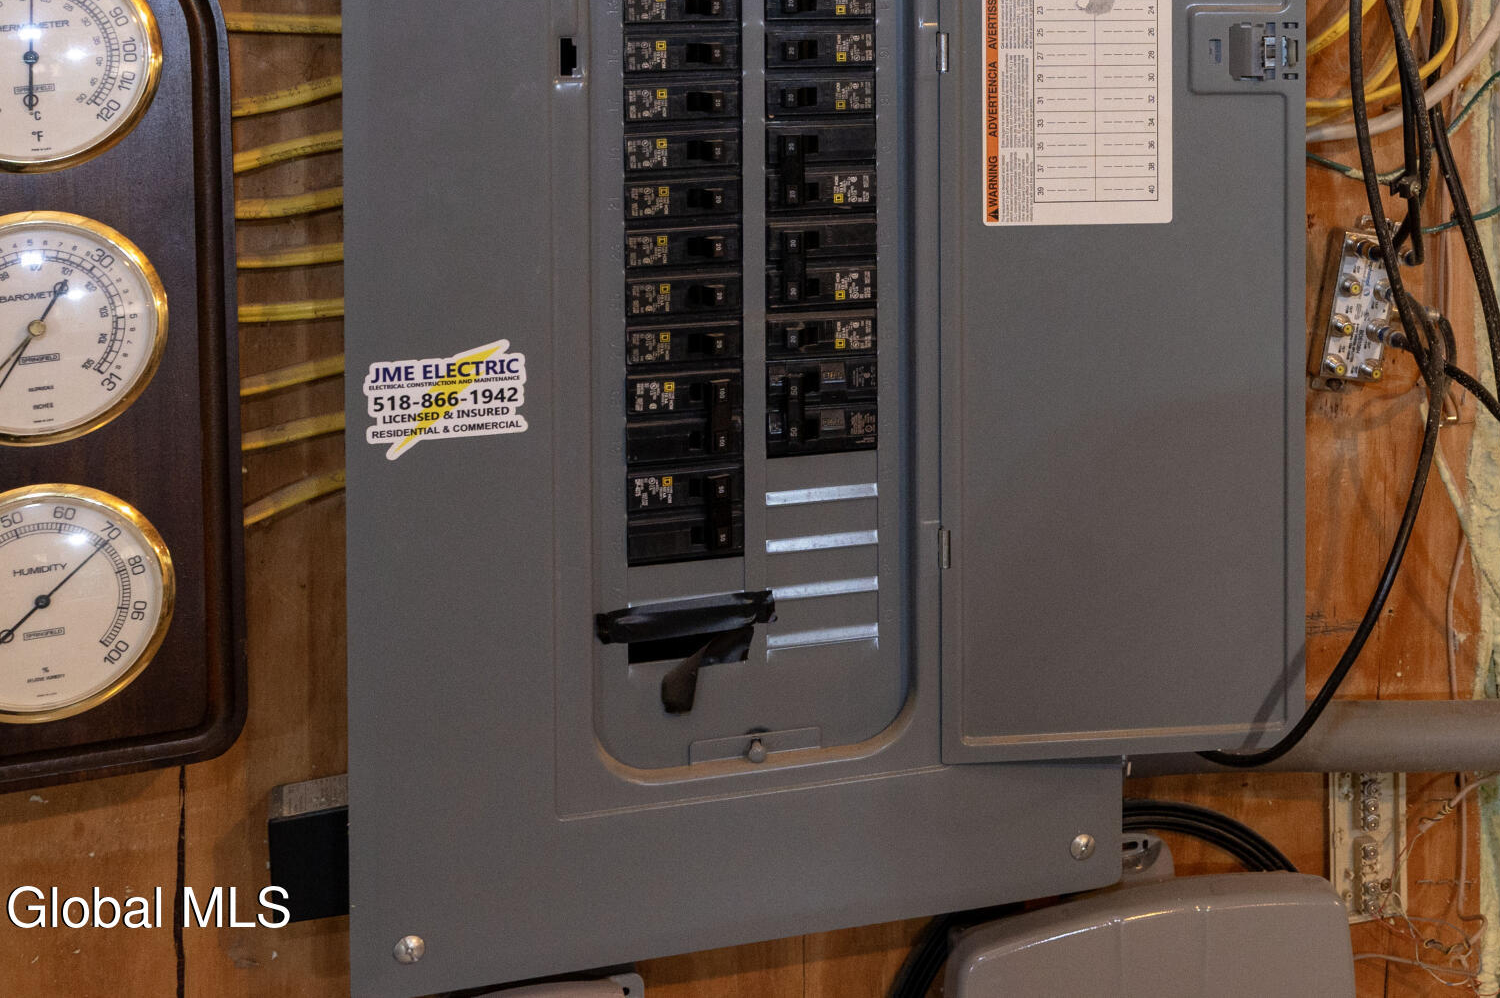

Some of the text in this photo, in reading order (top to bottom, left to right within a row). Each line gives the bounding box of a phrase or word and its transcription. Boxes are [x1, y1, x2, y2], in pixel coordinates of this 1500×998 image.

[63, 3, 74, 12] 25
[1037, 6, 1043, 14] 23
[1148, 6, 1154, 14] 24
[109, 7, 129, 27] 90
[1037, 28, 1043, 37] 25
[122, 37, 137, 62] 100
[96, 57, 103, 66] 40
[118, 71, 136, 91] 110
[1037, 74, 1043, 82] 29
[1148, 73, 1154, 81] 30
[76, 94, 87, 104] 50
[988, 60, 997, 138] ADVERTENCIA
[96, 99, 121, 122] 120
[1149, 118, 1154, 126] 34
[988, 155, 997, 207] WARNING
[1037, 187, 1044, 195] 39
[90, 248, 123, 391] 30 31
[371, 358, 519, 384] JME ELECTRIC
[369, 383, 405, 391] ELECTRICAL
[407, 380, 456, 388] CONSTRUCTION
[474, 375, 520, 383] MAINTENANCE
[373, 387, 518, 412] 518-866-1942
[382, 407, 510, 424] LICENSED & INSURED
[372, 426, 440, 439] RESIDENTIAL
[453, 420, 522, 432] COMMERCIAL
[13, 562, 67, 577] HUMIDITY
[0, 506, 147, 665] 50 60 70 80 90 100
